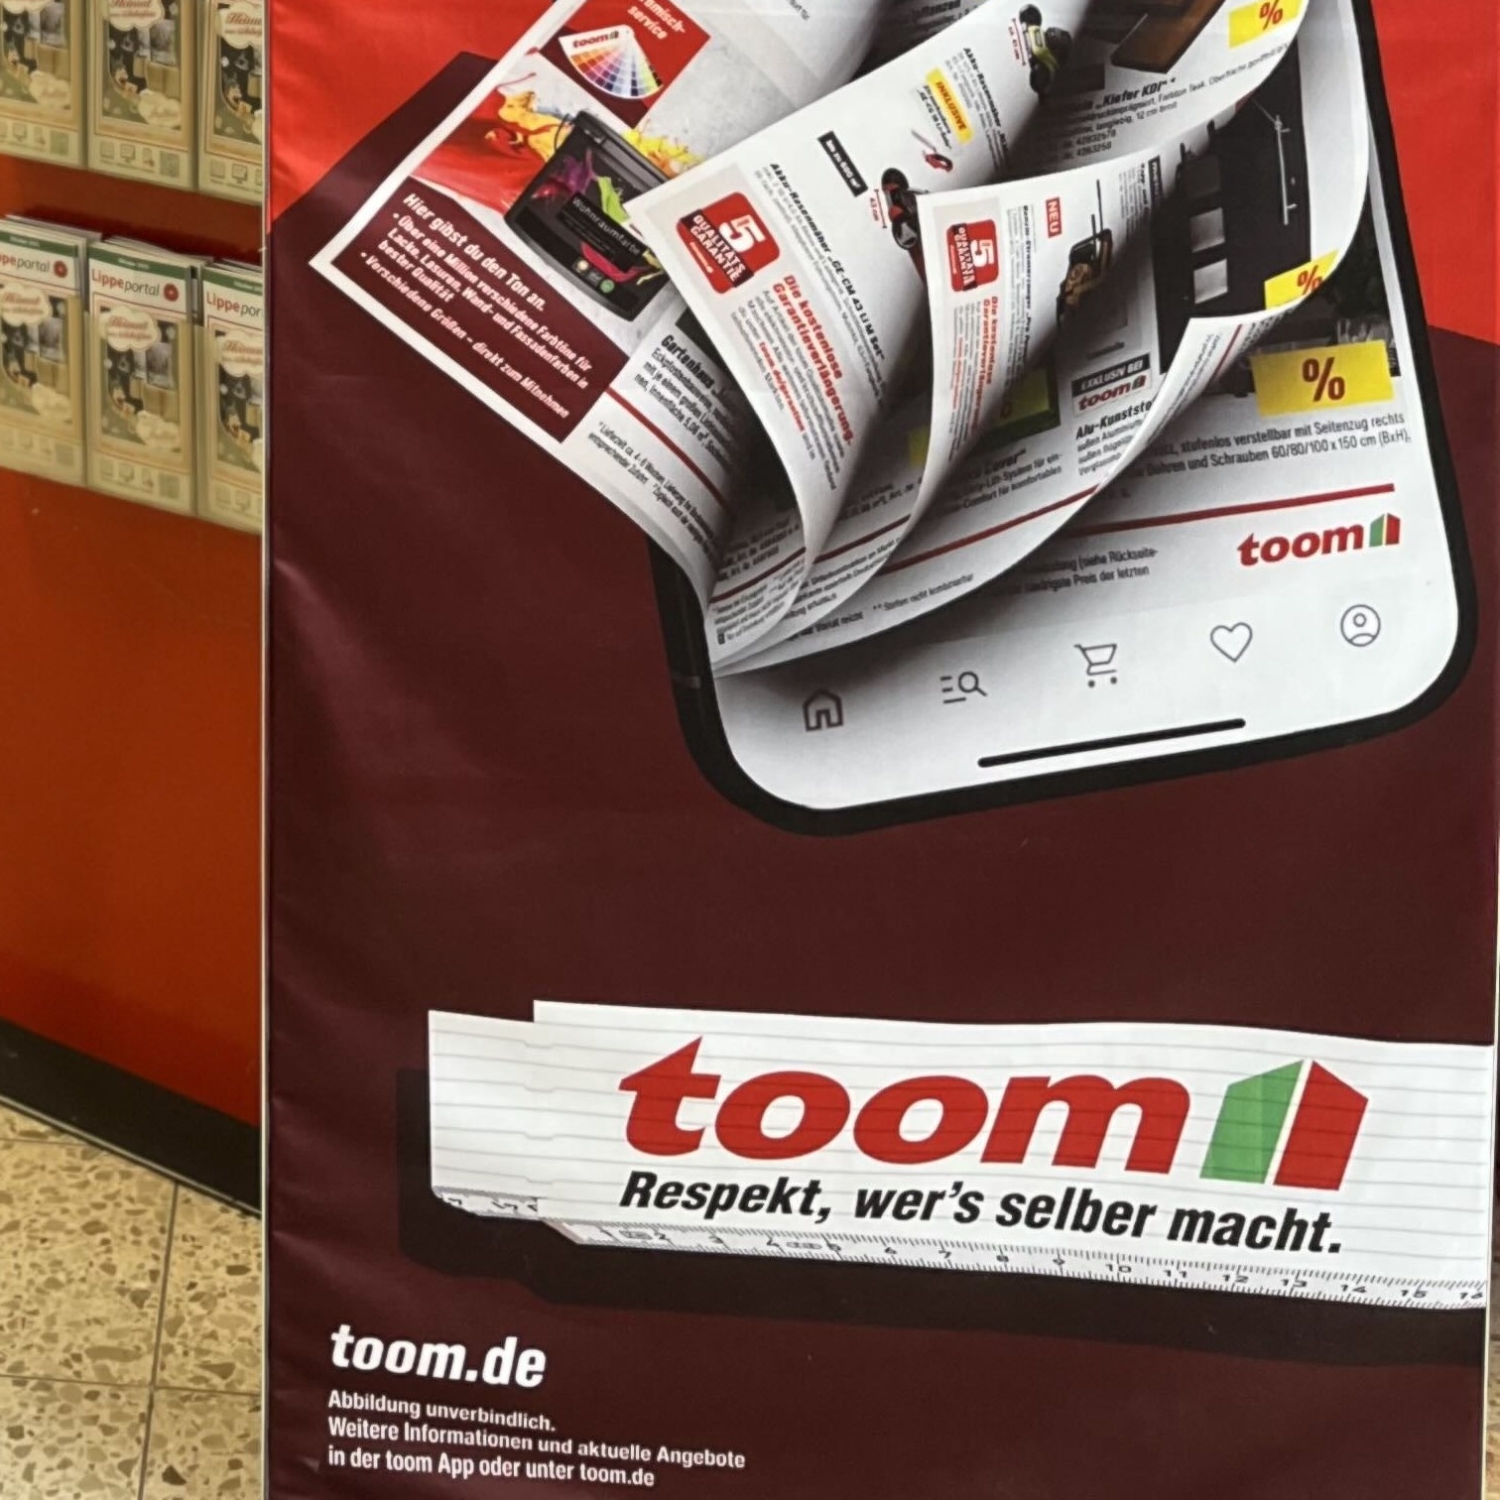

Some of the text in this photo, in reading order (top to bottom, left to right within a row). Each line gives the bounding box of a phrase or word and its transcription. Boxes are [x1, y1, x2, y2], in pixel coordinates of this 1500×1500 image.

[628, 6, 666, 38] service
[936, 82, 965, 130] INKLUSIVE
[573, 198, 638, 254] Wohnraumfarbe
[719, 214, 766, 252] 5
[1047, 199, 1059, 234] NEU
[378, 241, 453, 301] bester Qualität
[404, 194, 544, 310] Hier gibst du den Ton an.
[690, 226, 739, 282] GARANTIE
[971, 240, 993, 266] 5
[91, 268, 160, 297] Lippeportal
[398, 216, 591, 370] Über eine Million verschiedene Farbtöne für
[366, 256, 568, 417] Verschiedene Größen direkt zum Mitnehmen
[462, 287, 492, 312] Wand-
[493, 313, 513, 329] und
[511, 326, 578, 380] Fassadenfarben
[577, 379, 588, 388] in
[784, 276, 842, 378] Die kostenlose
[662, 336, 716, 388] Gartenhaus
[774, 284, 853, 443] Garantieverlängerung.
[1082, 360, 1142, 389] EXKLUSIV BEI
[1301, 357, 1346, 402] %
[662, 378, 681, 397] einem
[1076, 384, 1130, 410] toom
[1180, 413, 1404, 453] stufenlos verstellbar mit Seitenzug rechts
[1188, 456, 1208, 469] und
[1210, 449, 1268, 466] Schrauben
[1271, 440, 1328, 458] 60/80/100
[1338, 436, 1357, 448] 150
[1360, 436, 1376, 446] cm
[1237, 522, 1364, 567] toom
[1073, 566, 1148, 584] Preis der letzten
[617, 1034, 1191, 1172] toom
[619, 1170, 833, 1224] Respekt,
[996, 1185, 1153, 1243] selber
[1167, 1208, 1344, 1255] macht.
[330, 1324, 547, 1387] toom.de
[328, 1390, 556, 1432] Abbildung unverbindlich.
[328, 1416, 746, 1469] Weitere Informationen und aktuelle Angebote
[328, 1445, 655, 1487] in der toom App oder unter toom.de
